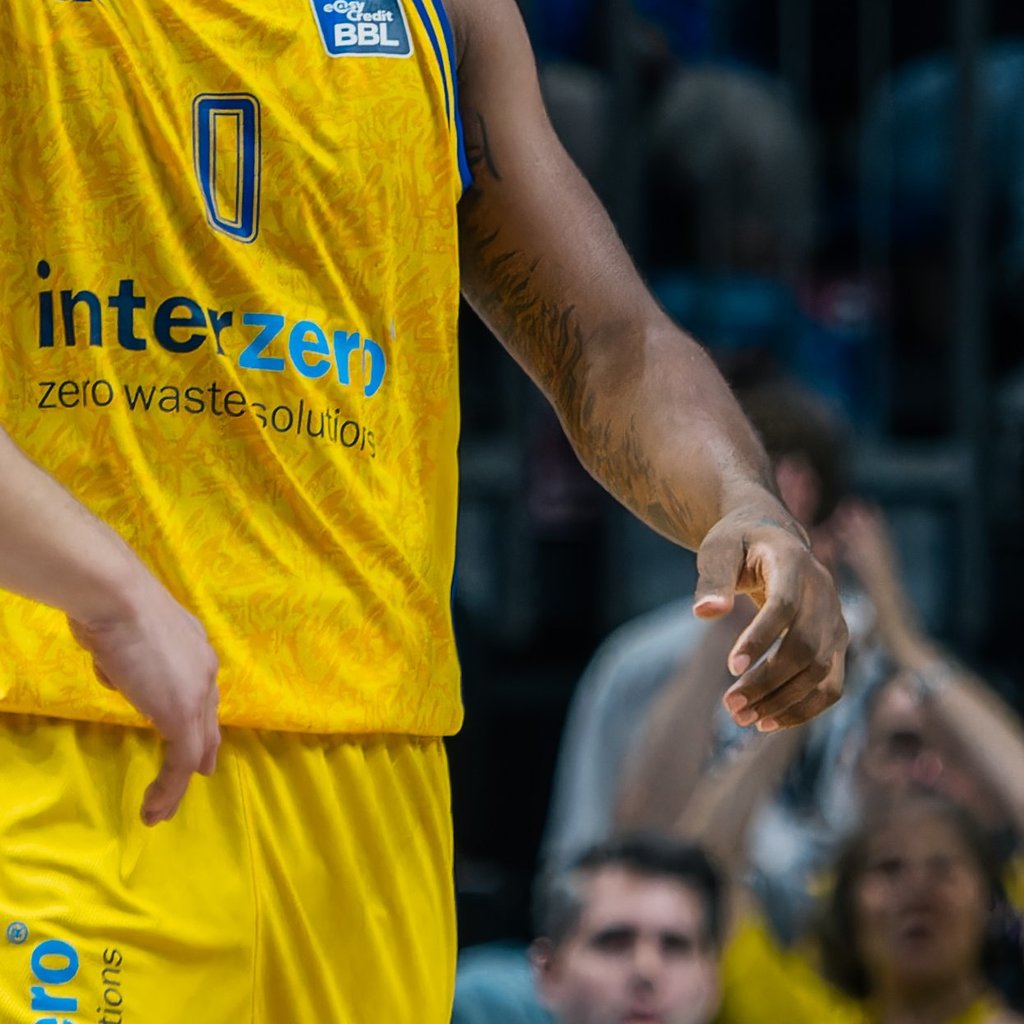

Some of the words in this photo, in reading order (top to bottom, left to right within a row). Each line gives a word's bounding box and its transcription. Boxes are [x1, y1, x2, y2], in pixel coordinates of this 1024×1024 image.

[334, 22, 400, 47] BBL
[192, 92, 261, 244] 0
[38, 379, 114, 409] zero
[124, 382, 247, 418] waste
